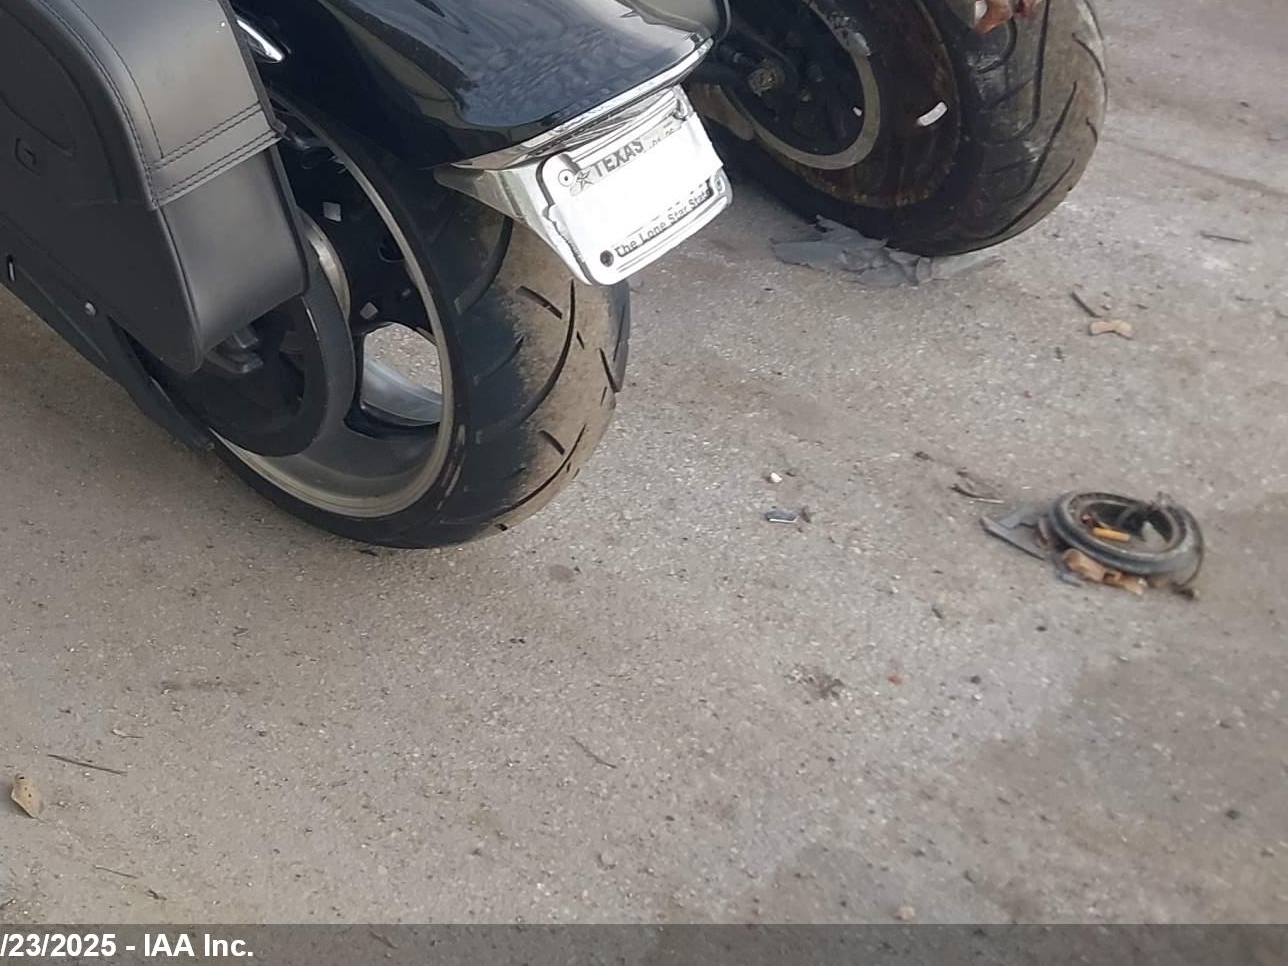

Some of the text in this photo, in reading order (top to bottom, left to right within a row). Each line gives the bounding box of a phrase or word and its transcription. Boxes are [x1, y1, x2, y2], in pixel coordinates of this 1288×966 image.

[593, 140, 643, 177] TEXAS
[614, 240, 638, 258] The
[639, 221, 667, 243] Lone
[668, 205, 688, 224] Star
